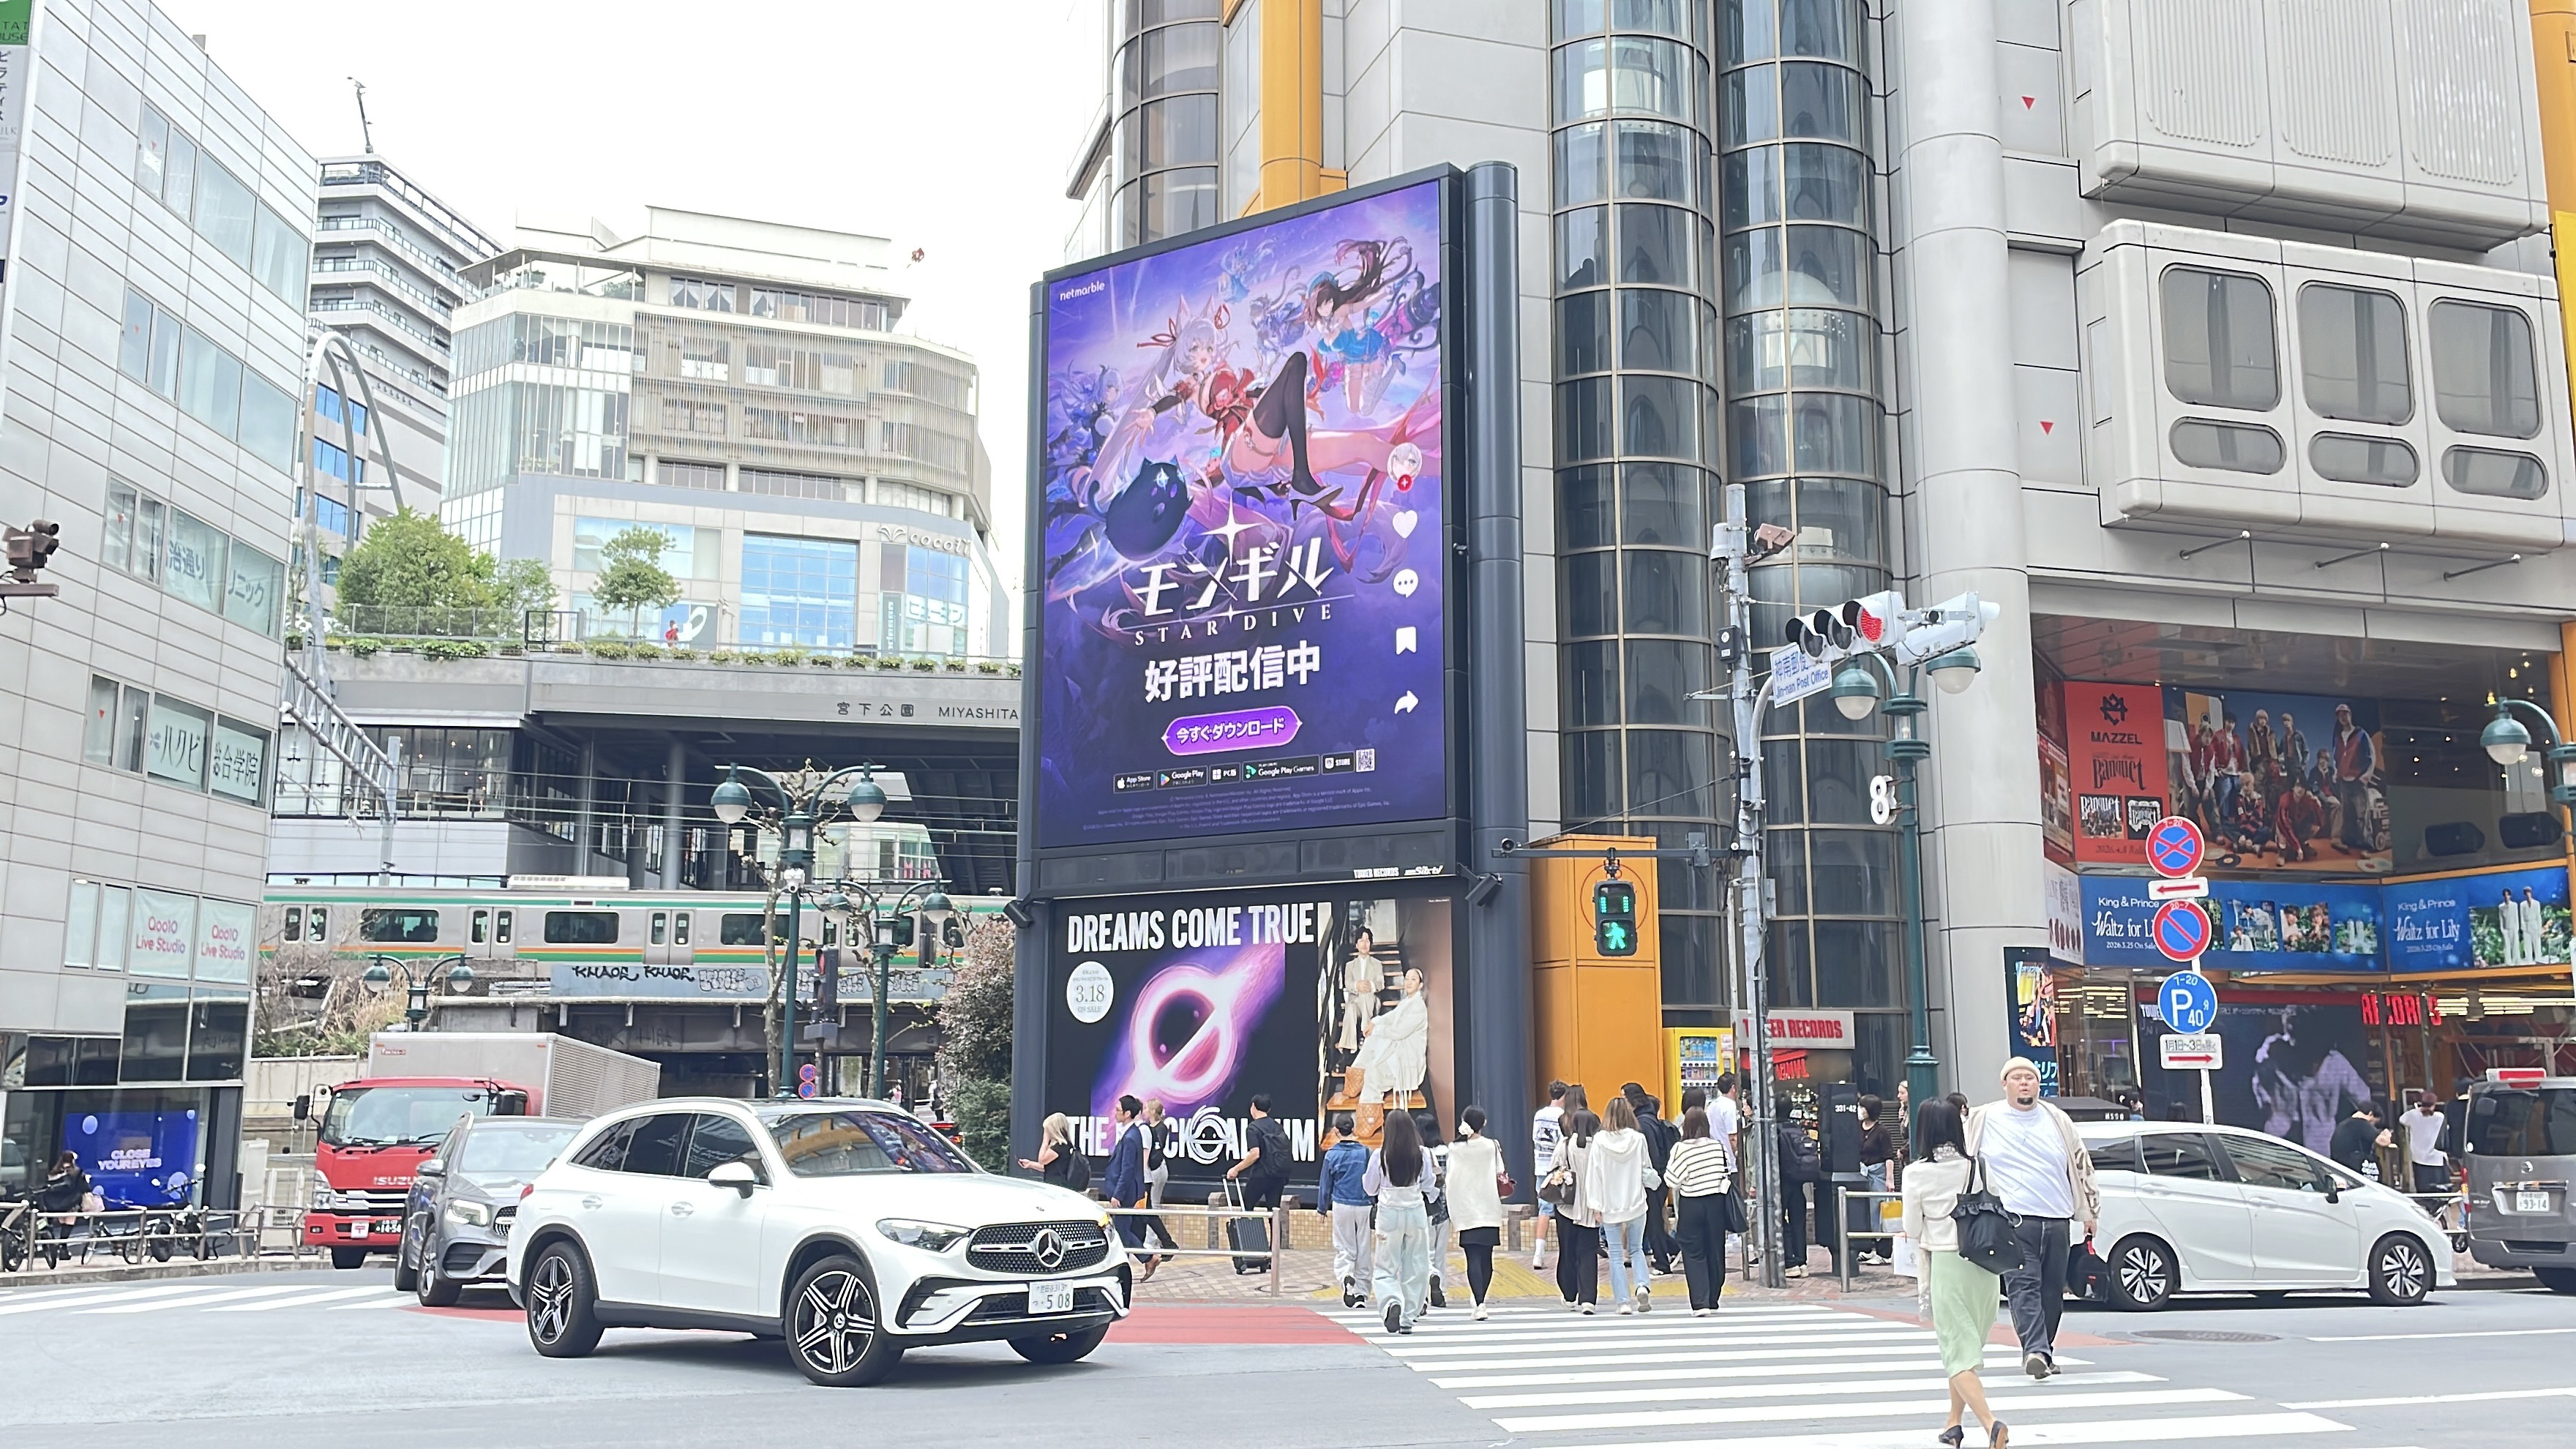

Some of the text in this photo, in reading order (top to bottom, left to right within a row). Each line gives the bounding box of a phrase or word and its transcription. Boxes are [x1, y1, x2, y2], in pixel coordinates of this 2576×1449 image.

[1060, 280, 1106, 302] netmarble
[1132, 538, 1335, 617] モンギル
[1134, 603, 1331, 645] STAR DIVE
[1145, 640, 1320, 703] 好評配信中
[1797, 675, 1810, 690] Post
[1811, 669, 1829, 685] Office
[938, 706, 1019, 720] MIYASHITA
[1176, 716, 1286, 745] 今すぐダウンロード
[2091, 731, 2143, 745] MAZZEL
[1126, 776, 1137, 784] App
[1172, 769, 1205, 781] Google Play
[1258, 769, 1280, 777] Google
[1281, 767, 1293, 775] Play
[1870, 776, 1890, 825] 8
[2080, 795, 2122, 821] Banquet
[1373, 866, 1399, 877] RECORDS
[2098, 896, 2160, 908] King & Prince
[2170, 901, 2190, 910] 20-7
[2397, 903, 2417, 912] King
[149, 916, 178, 935] Qoo10
[211, 924, 239, 942] Qoo10
[1068, 902, 1315, 953] DREAMS COME TRUE
[2092, 910, 2124, 937] Waltz
[2127, 918, 2142, 937] for
[2392, 916, 2460, 943] Waltz for Lily
[136, 933, 185, 954] Live Studio
[201, 942, 245, 960] Live Studio
[2174, 975, 2198, 986] 7-20
[1076, 984, 1105, 1003] 3.18
[2171, 989, 2193, 1027] P
[2188, 1009, 2204, 1027] 40
[1787, 1019, 1843, 1038] RECORDS
[1067, 1116, 1109, 1157] THE
[111, 1148, 151, 1160] CLOSE
